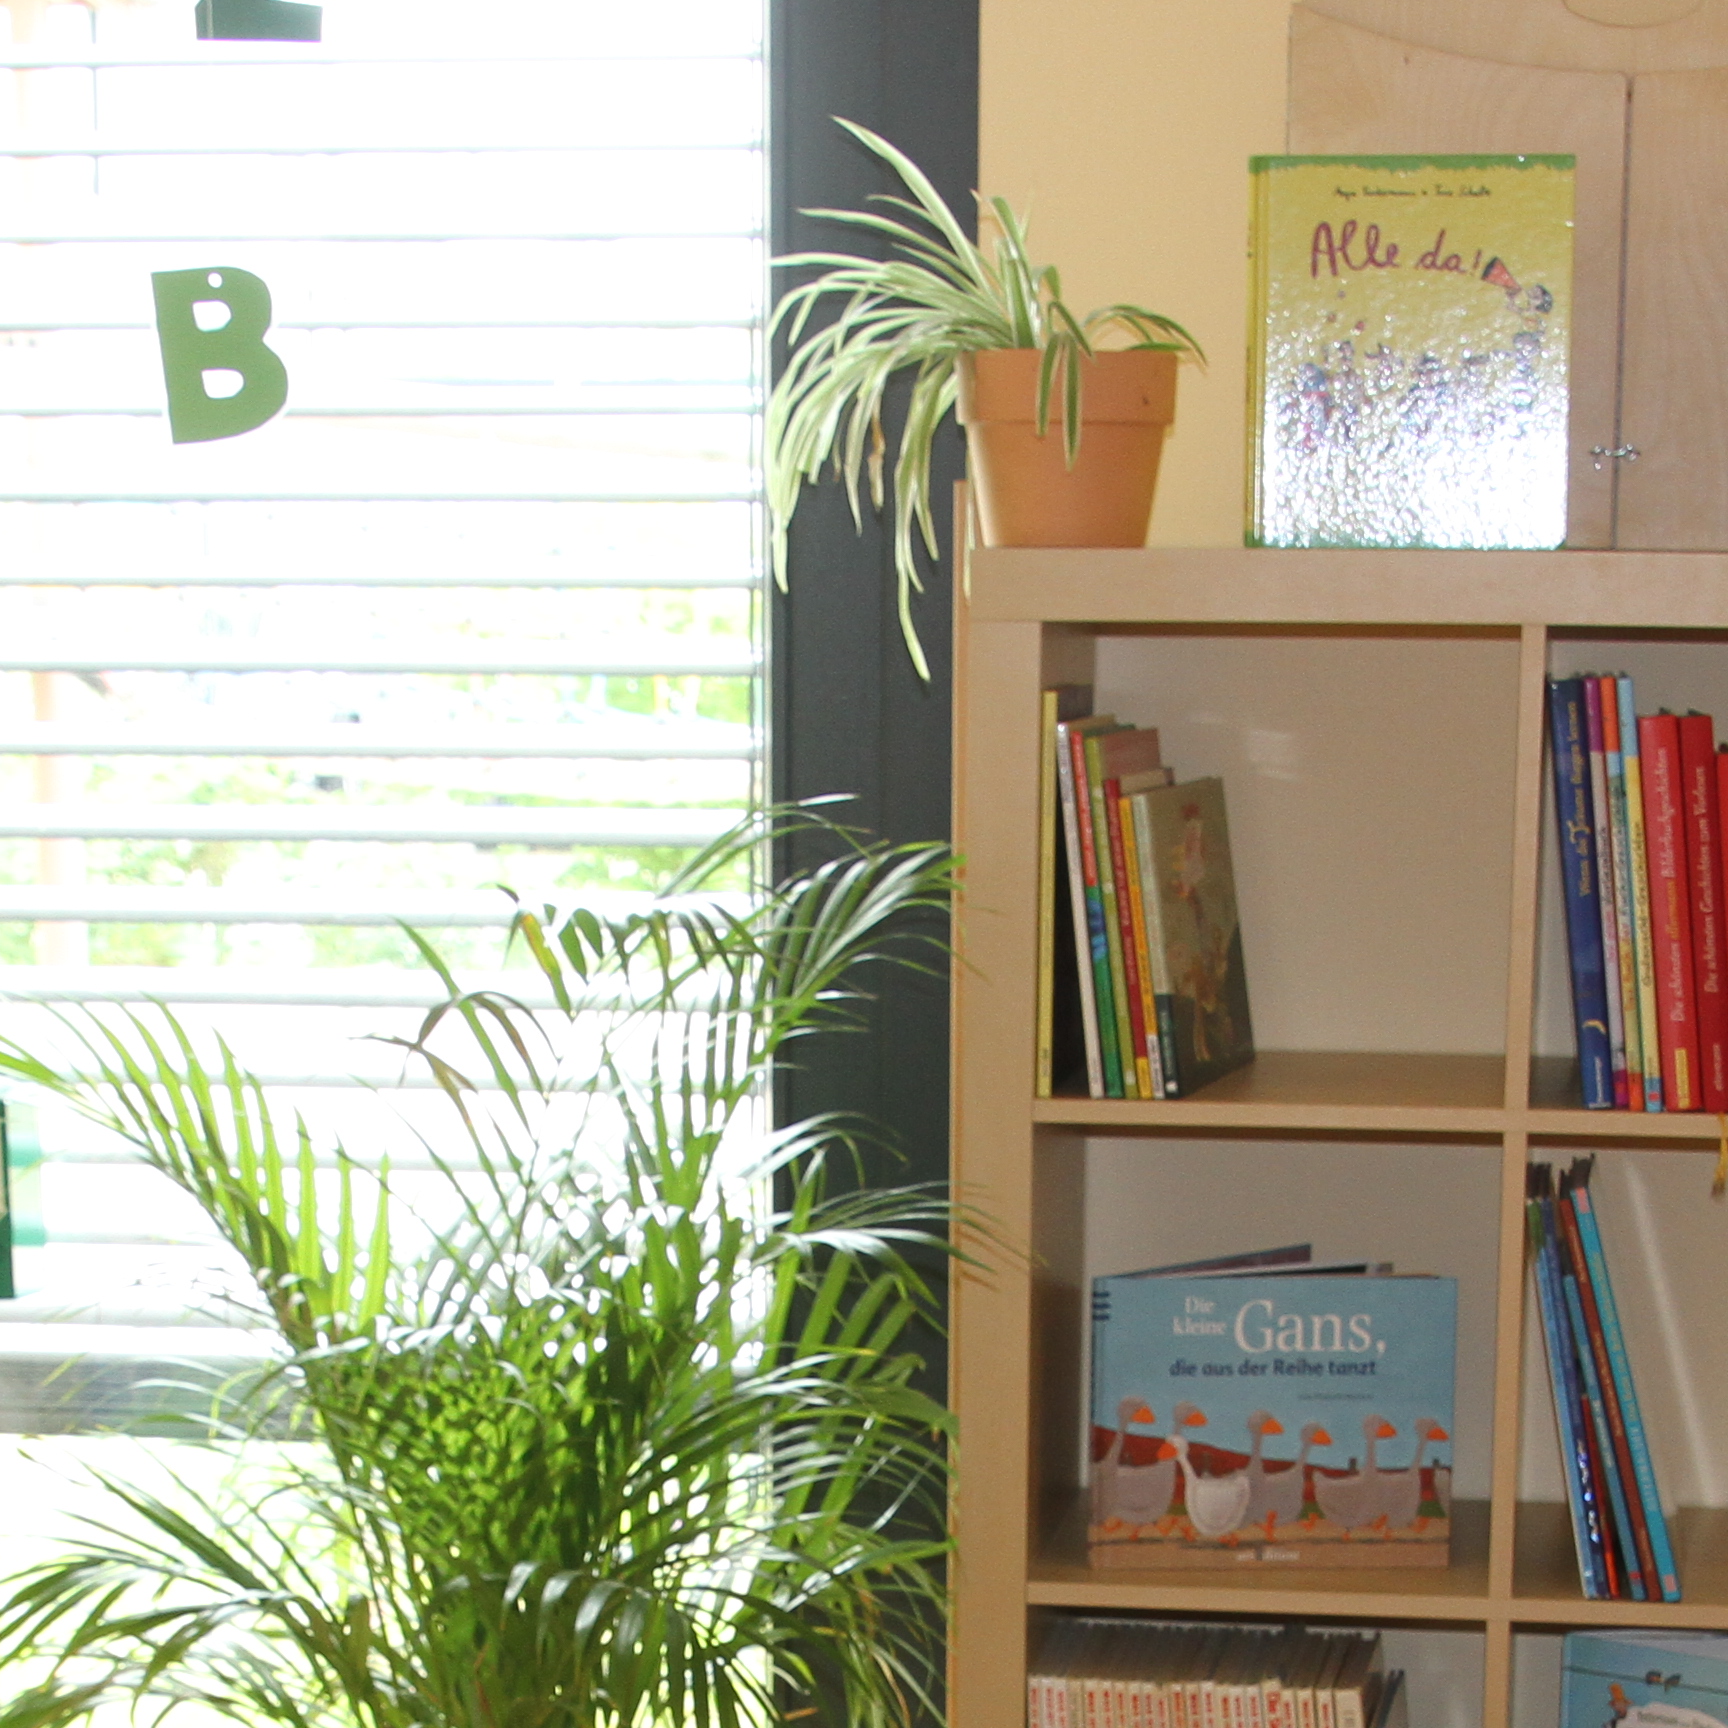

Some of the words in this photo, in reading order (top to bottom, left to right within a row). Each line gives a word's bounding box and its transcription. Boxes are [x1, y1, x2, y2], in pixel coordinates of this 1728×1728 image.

[1310, 219, 1401, 279] Alle
[1415, 229, 1483, 276] da!
[150, 266, 289, 444] B
[1185, 1296, 1216, 1314] Die
[1235, 1299, 1386, 1359] Gans,
[1169, 1358, 1198, 1376] die
[1202, 1361, 1234, 1377] aus
[1238, 1357, 1267, 1377] der
[1273, 1358, 1323, 1376] Reihe
[1328, 1360, 1376, 1376] tanzt
